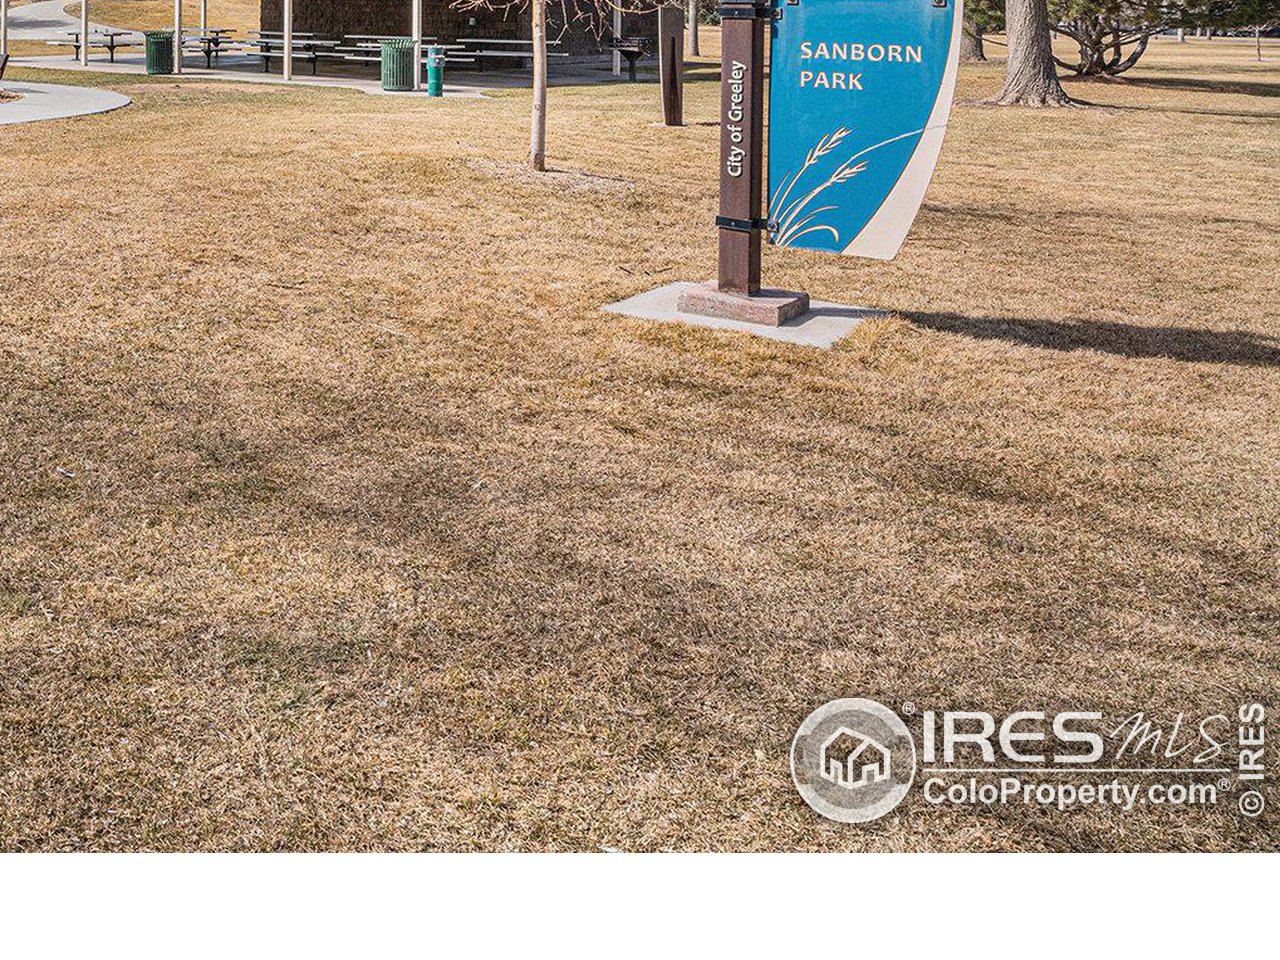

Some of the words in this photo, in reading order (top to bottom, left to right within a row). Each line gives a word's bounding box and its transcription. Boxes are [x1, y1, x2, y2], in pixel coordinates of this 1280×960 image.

[799, 41, 922, 63] SANBORN
[799, 69, 864, 90] PARK
[727, 60, 747, 122] Greeley
[727, 124, 743, 143] of
[727, 146, 746, 177] City
